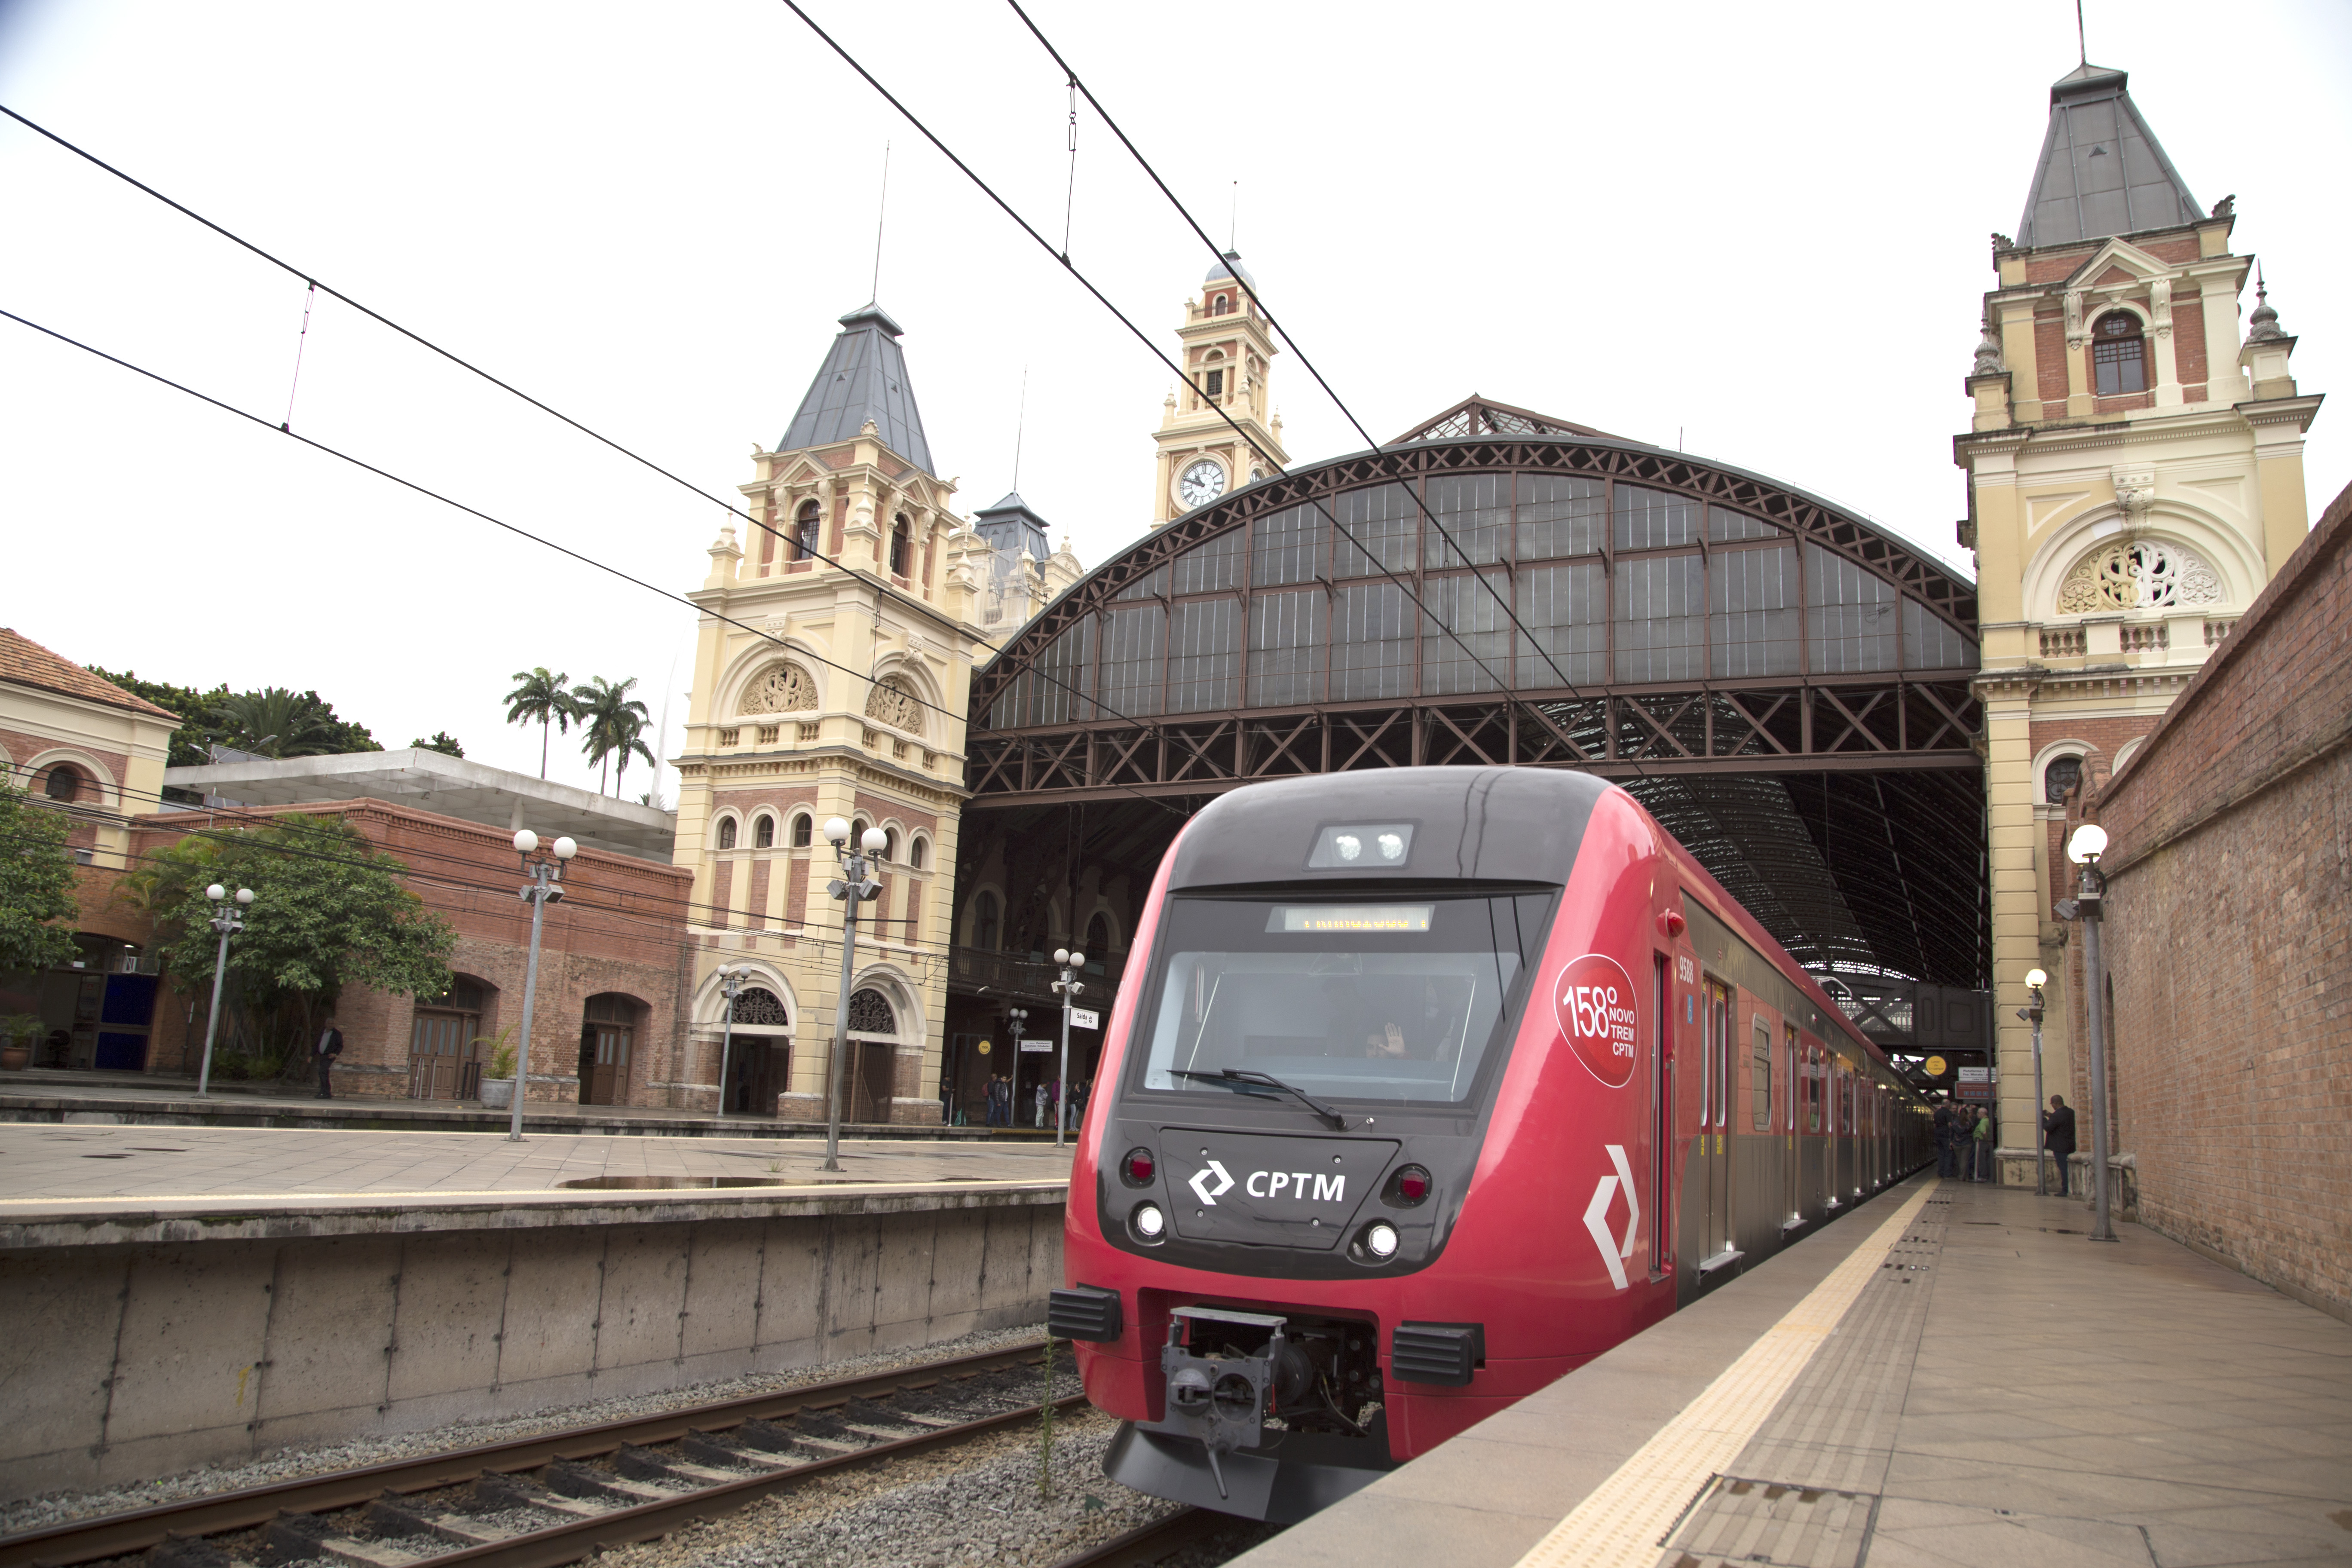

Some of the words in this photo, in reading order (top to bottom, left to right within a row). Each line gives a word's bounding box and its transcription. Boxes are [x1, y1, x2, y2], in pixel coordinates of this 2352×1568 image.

[1679, 955, 1694, 985] 9588
[1609, 1007, 1635, 1025] NOVO
[1611, 1024, 1634, 1041] TREM
[1613, 1041, 1634, 1058] CPTM
[1246, 1170, 1346, 1202] CPTM
